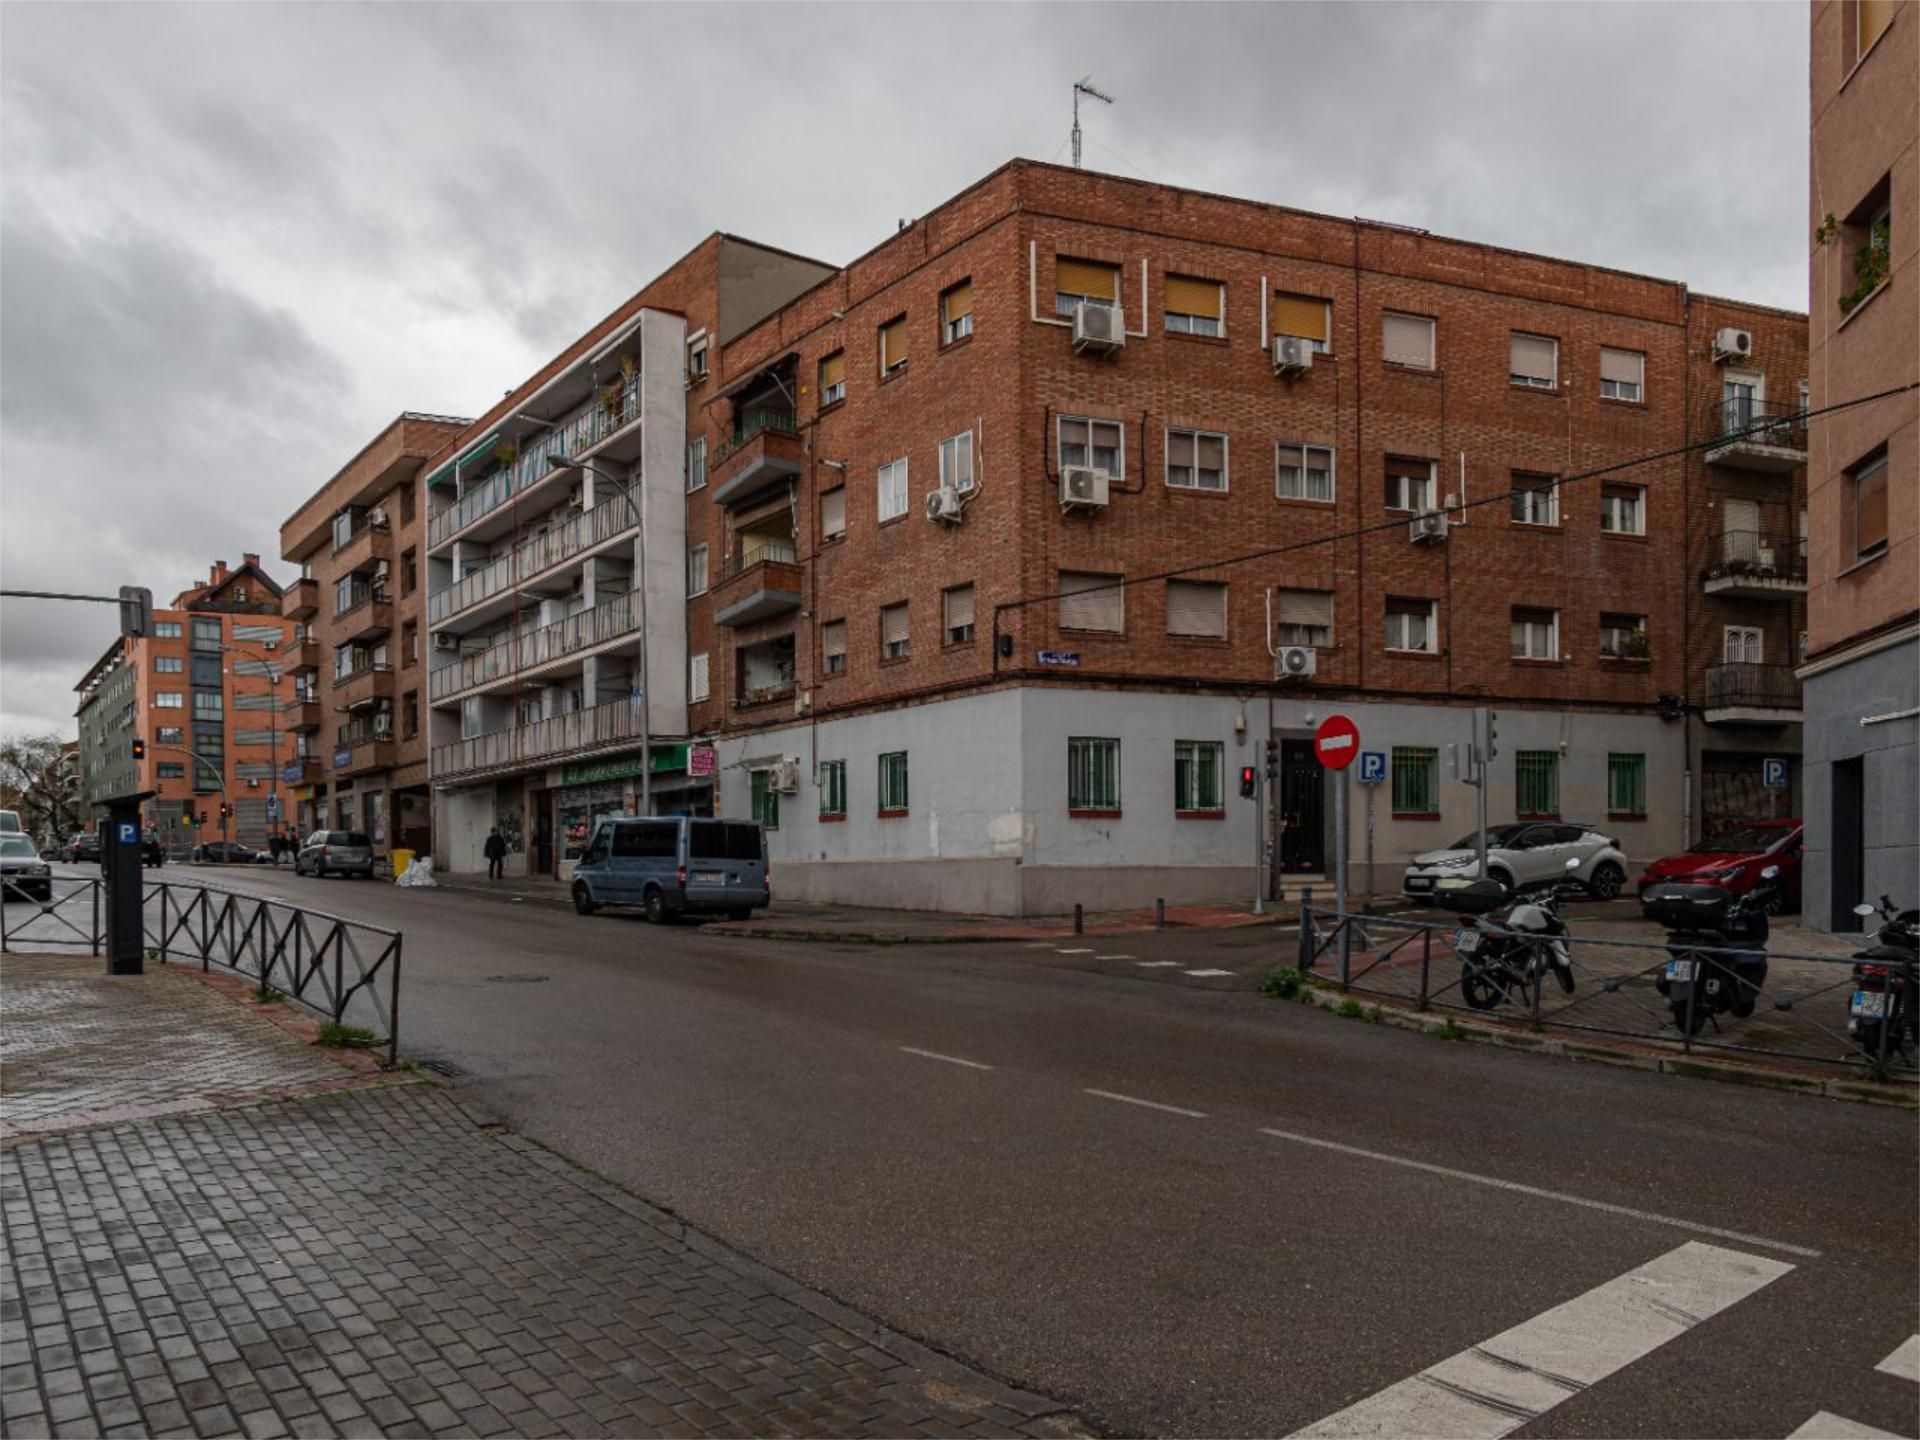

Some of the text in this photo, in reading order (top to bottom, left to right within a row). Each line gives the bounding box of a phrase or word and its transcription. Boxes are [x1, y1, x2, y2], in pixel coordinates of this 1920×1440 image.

[1365, 755, 1381, 778] P
[1769, 762, 1782, 783] P
[120, 824, 134, 840] P
